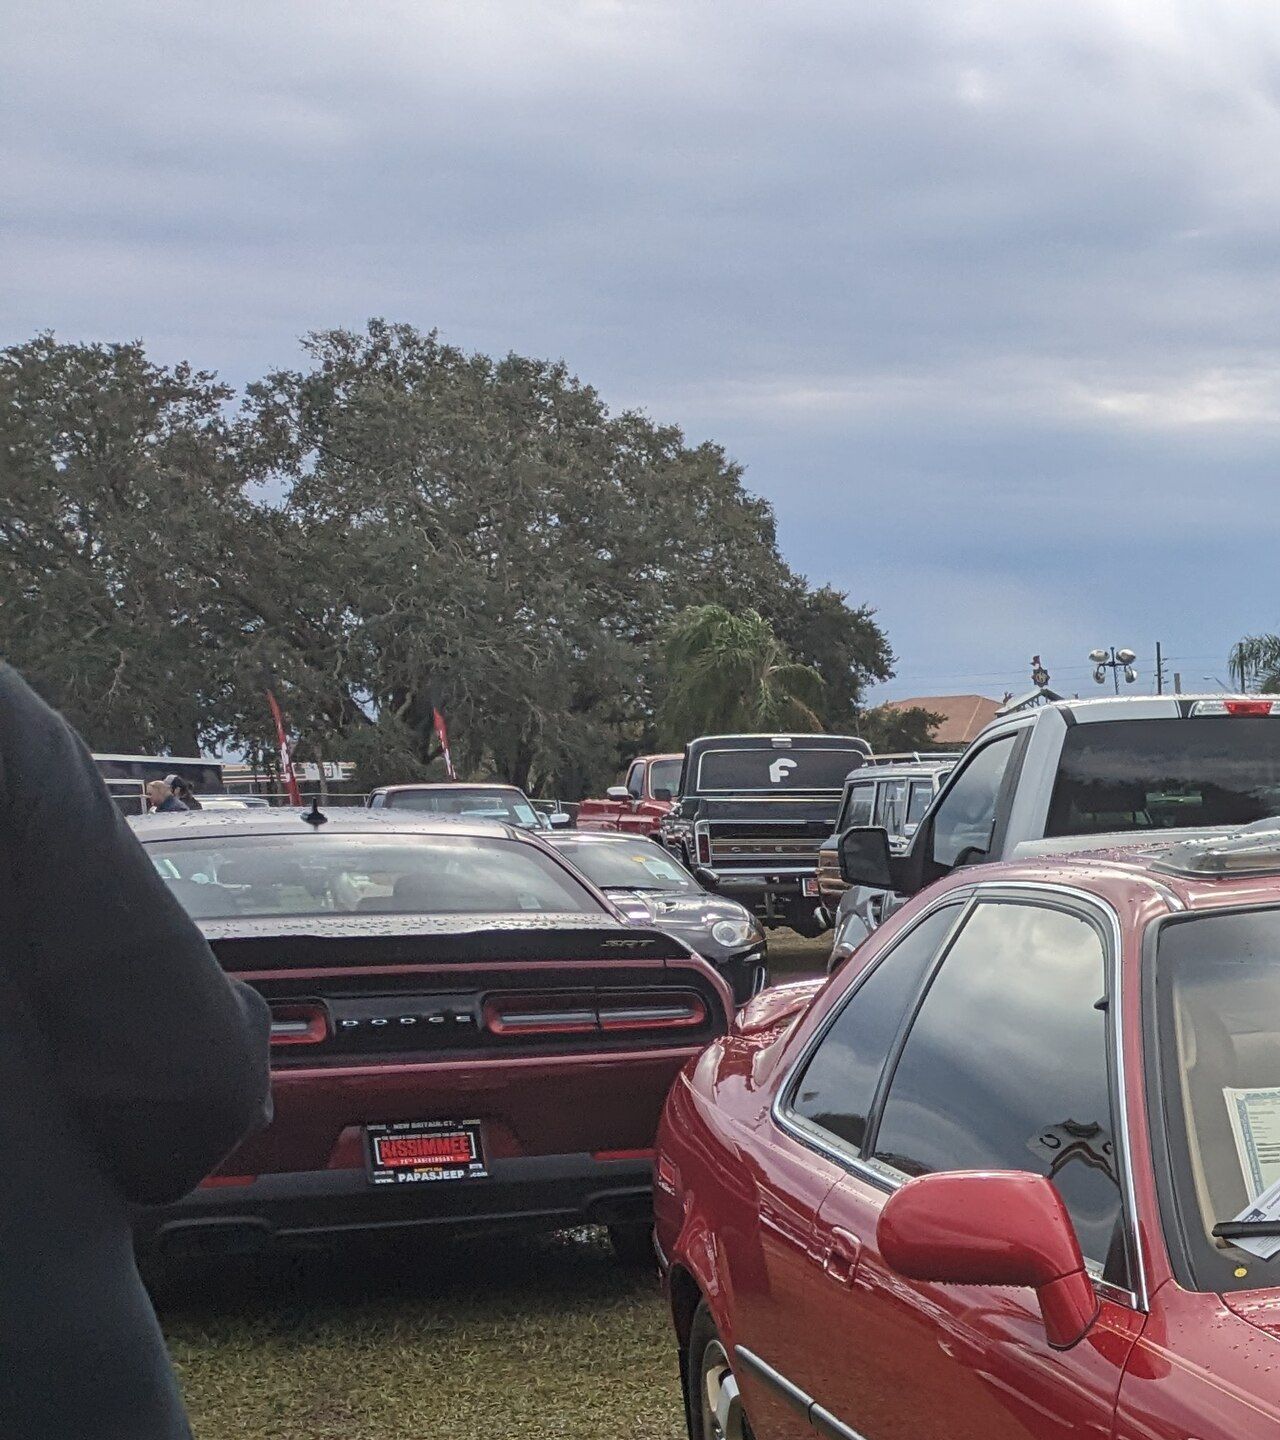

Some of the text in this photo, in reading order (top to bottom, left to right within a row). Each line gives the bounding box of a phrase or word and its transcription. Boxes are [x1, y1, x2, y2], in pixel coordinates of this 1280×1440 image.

[342, 1015, 471, 1026] DODGE
[380, 1137, 470, 1159] KISSIMMEE
[398, 1170, 465, 1183] PAPASJEEP
